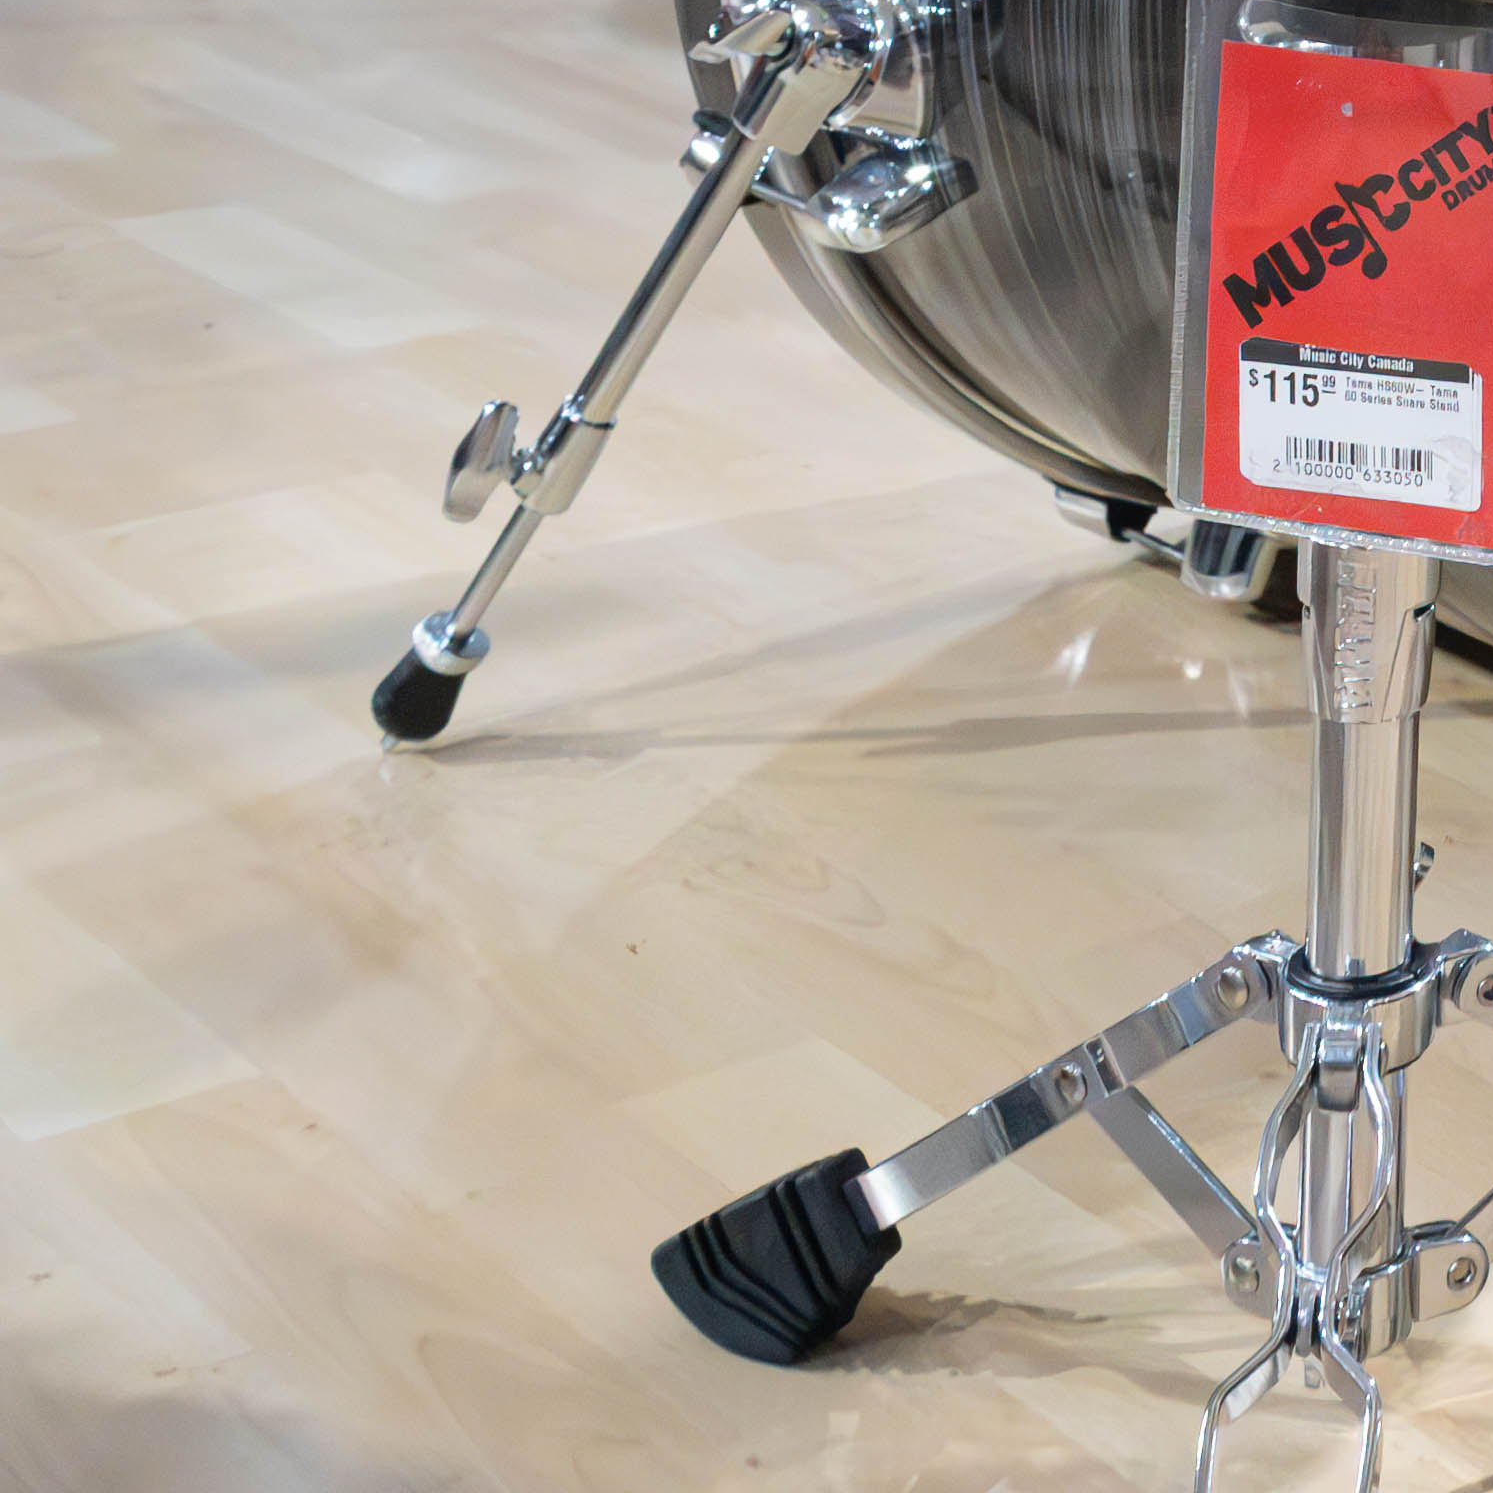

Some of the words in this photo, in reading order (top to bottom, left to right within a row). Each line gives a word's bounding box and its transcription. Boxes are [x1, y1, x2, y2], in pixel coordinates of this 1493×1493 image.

[1299, 347, 1336, 364] Music
[1340, 354, 1364, 369] City
[1367, 355, 1415, 373] Canada
[1345, 376, 1373, 390] Tama
[1430, 385, 1458, 399] Tama
[1360, 393, 1392, 406] Series
[1430, 399, 1459, 412] Stand
[1273, 460, 1281, 473] 2
[1295, 462, 1354, 480] 100000
[1363, 469, 1423, 487] 633050
